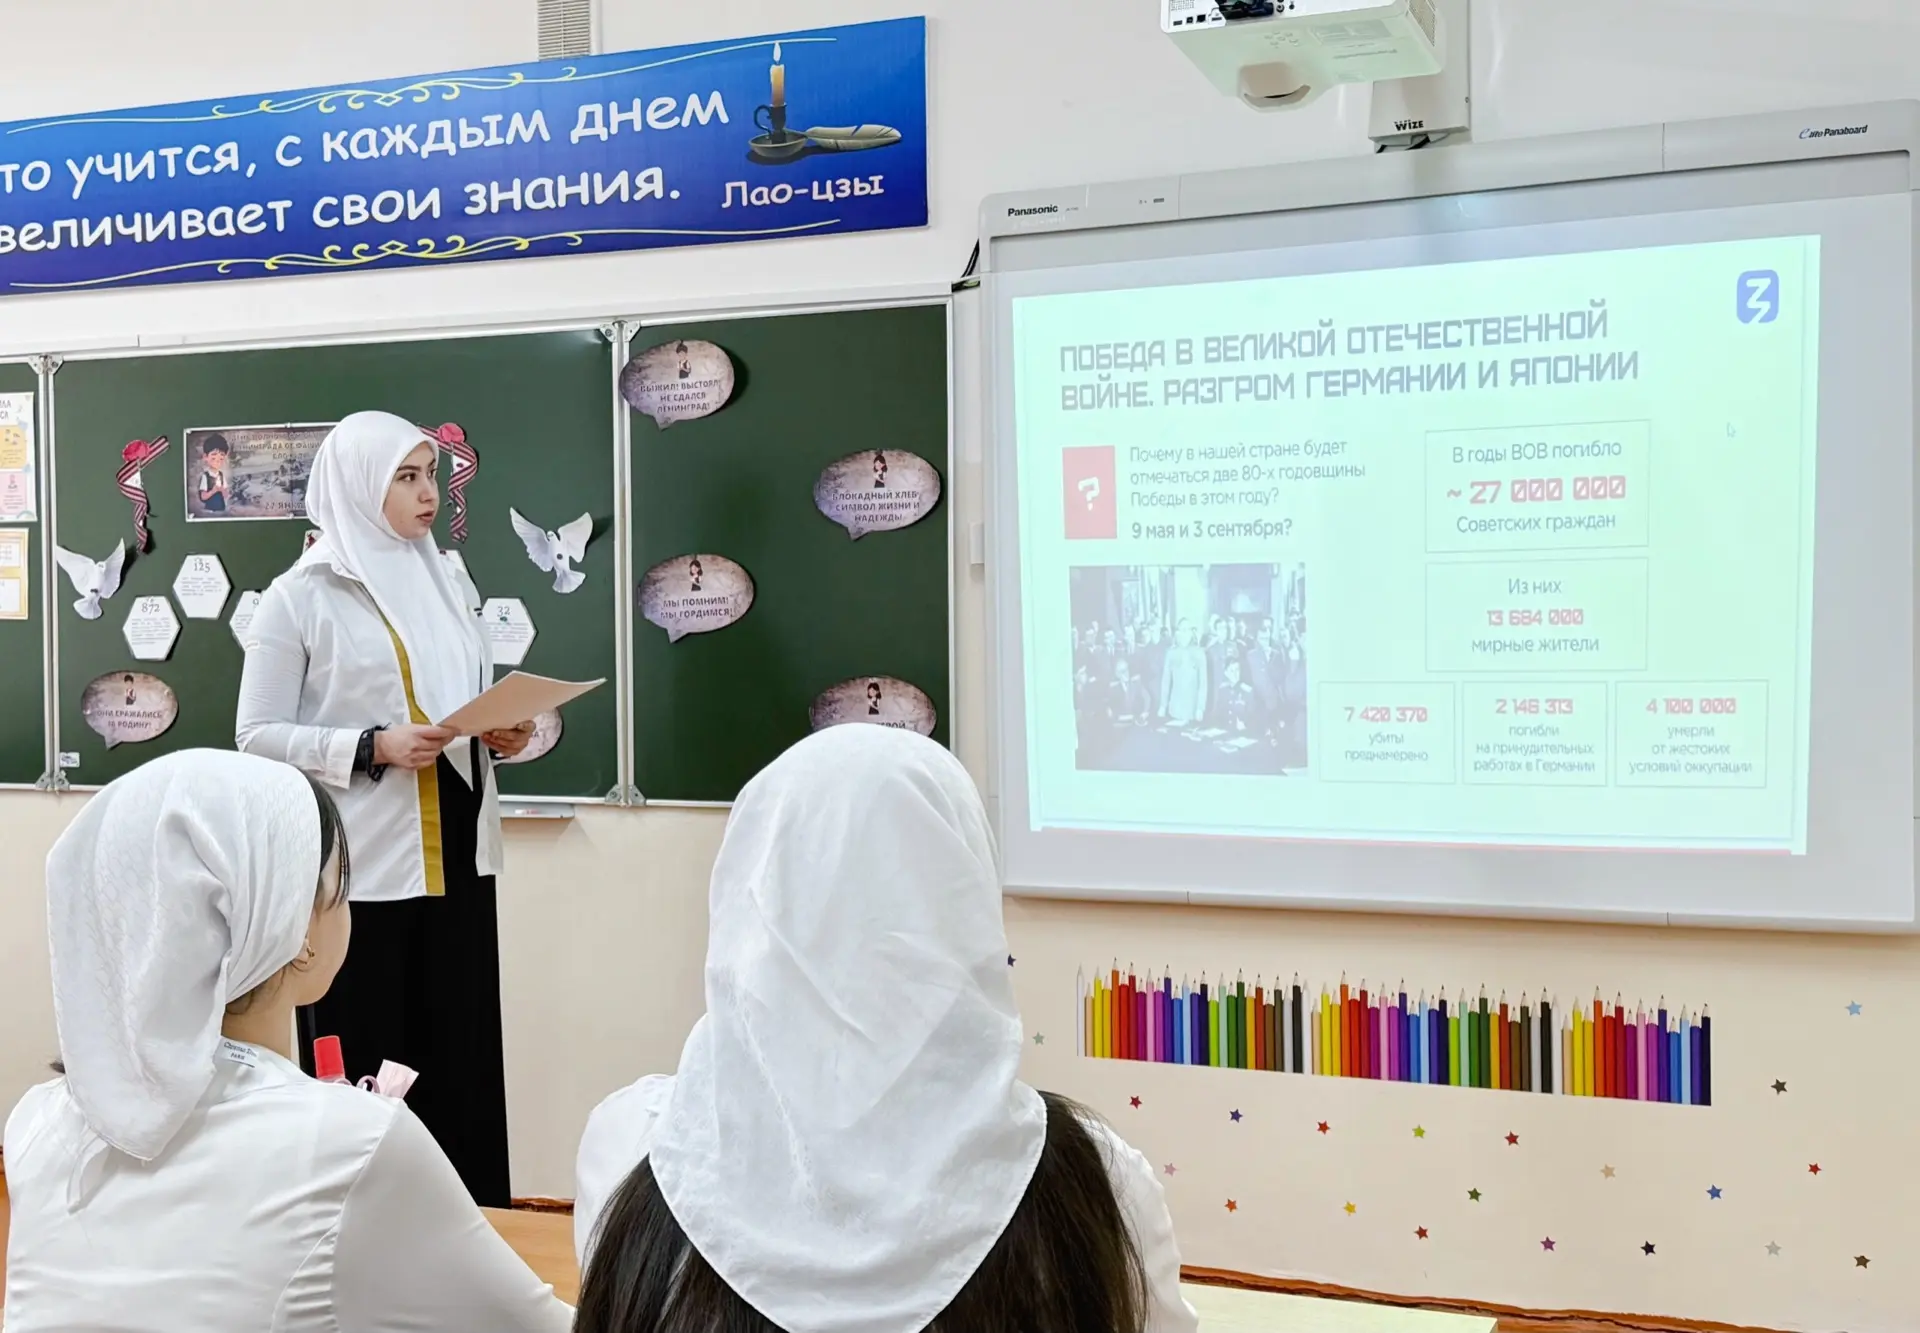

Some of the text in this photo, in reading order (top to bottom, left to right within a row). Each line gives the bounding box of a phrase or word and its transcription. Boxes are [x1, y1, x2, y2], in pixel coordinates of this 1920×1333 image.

[1823, 124, 1869, 137] Panaboard
[66, 141, 256, 199] учится,
[275, 135, 303, 167] с
[323, 109, 551, 163] каждым
[570, 90, 729, 145] днем
[312, 187, 441, 229] свои
[464, 166, 680, 216] знания.
[721, 174, 885, 209] Лао-цзы
[1007, 184, 1058, 197] Panasonic
[1060, 298, 1608, 373] ПОБЕДА В ВЕЛИКОЙ ОТЕЧЕСТВЕННОЙ
[1061, 350, 1639, 411] ВОЙНЕ. РАЗГРОМ ГЕРМАНИИ И ЯПОНИИ
[660, 394, 671, 402] НЕ
[1130, 440, 1348, 464] Почему в нашей стране будет
[1452, 440, 1622, 464] В годы ВОВ погибло
[1130, 464, 1366, 486] отмечаться две 80-х годовщины
[1131, 487, 1279, 508] Победы в этом году?
[1469, 480, 1502, 505] 27
[1510, 477, 1563, 503] 000
[1573, 475, 1627, 501] 000
[878, 502, 911, 511] ЖИЗНИ
[913, 501, 920, 509] И
[1131, 518, 1293, 540] 9 мая и 3 сентября?
[1456, 514, 1616, 533] Советских граждан
[193, 562, 211, 573] 125
[1508, 578, 1562, 595] Из них
[141, 603, 161, 615] 872
[496, 605, 511, 617] 32
[663, 600, 680, 608] МЫ
[660, 611, 677, 619] МЫ
[1487, 608, 1584, 626] 13 684 000
[1471, 637, 1600, 655] мирные жители
[1343, 706, 1428, 723] 7 420 370
[1495, 698, 1508, 715] 2
[1544, 698, 1574, 715] 313
[1645, 698, 1737, 715] 4 100 000
[1368, 731, 1404, 746] убиты
[1508, 723, 1560, 738] погибли
[1667, 725, 1716, 740] умерли
[1476, 742, 1594, 757] на принудительных
[1651, 743, 1731, 756] от жестоких
[1473, 758, 1596, 774] работах в Германии
[1628, 759, 1753, 775] условий оккупации
